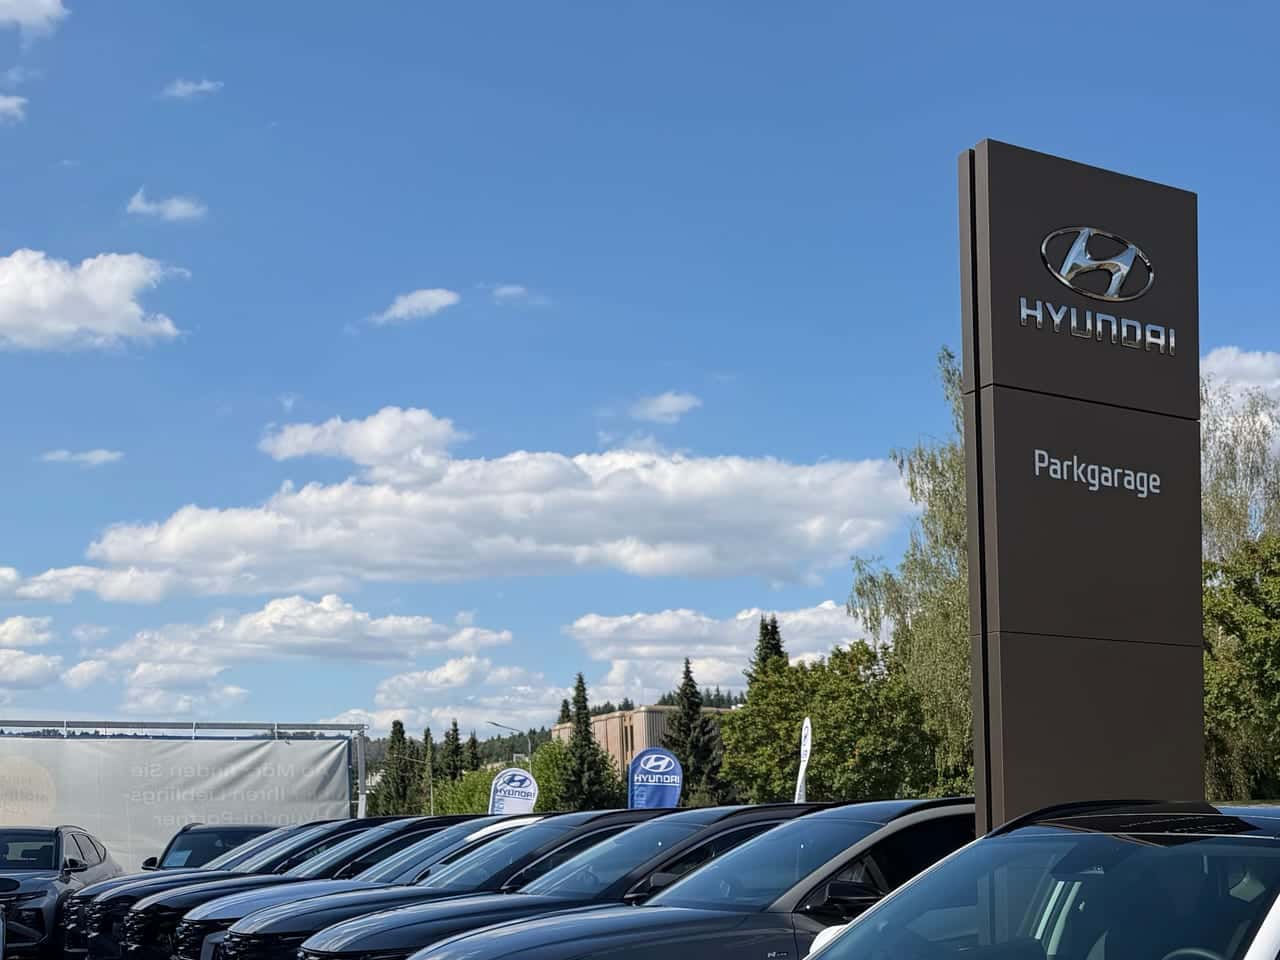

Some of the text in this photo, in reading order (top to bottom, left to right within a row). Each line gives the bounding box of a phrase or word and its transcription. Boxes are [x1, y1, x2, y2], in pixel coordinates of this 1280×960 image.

[1019, 296, 1176, 356] HYUNDAI
[1033, 449, 1161, 499] Parkgarage
[634, 773, 681, 784] HYUNDAI
